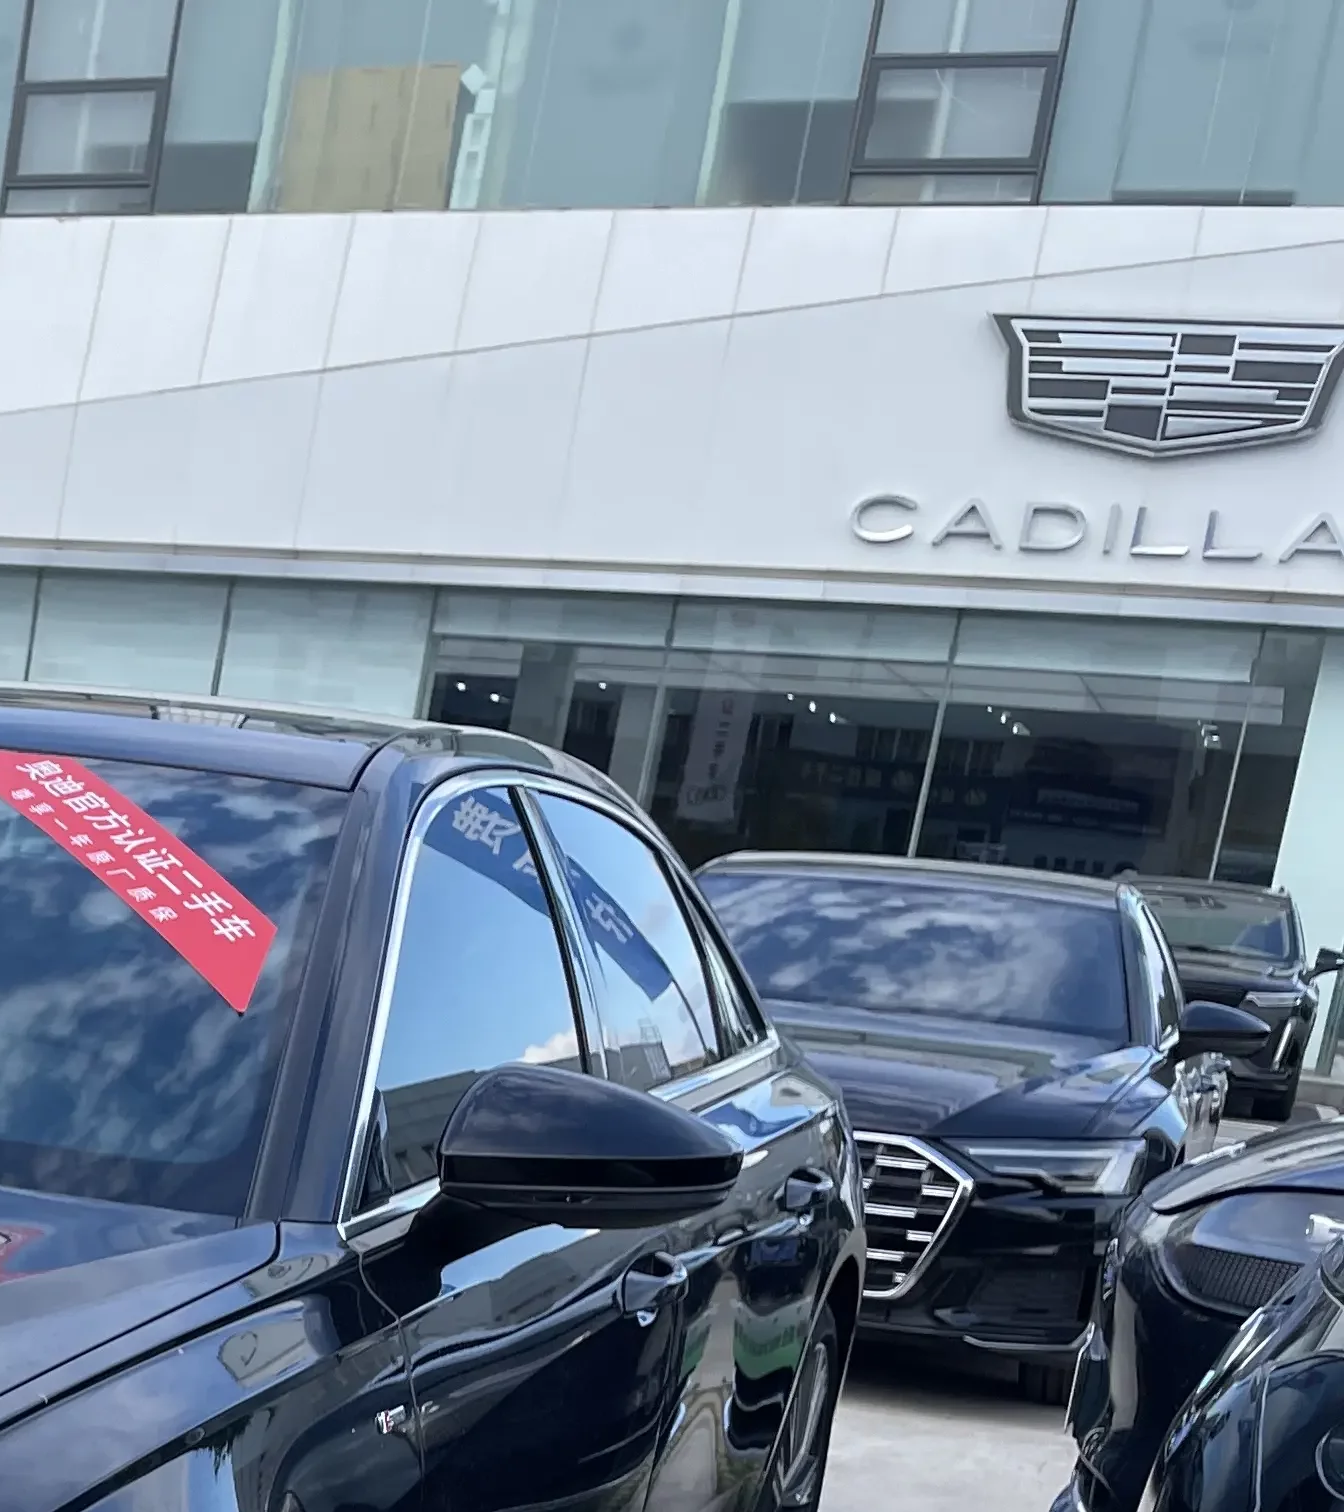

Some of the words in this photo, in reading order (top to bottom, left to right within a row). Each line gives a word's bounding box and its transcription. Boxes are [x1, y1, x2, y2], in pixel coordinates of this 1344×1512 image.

[850, 493, 1344, 564] CADILLA
[16, 759, 256, 942] 奥迪官方认证二手车
